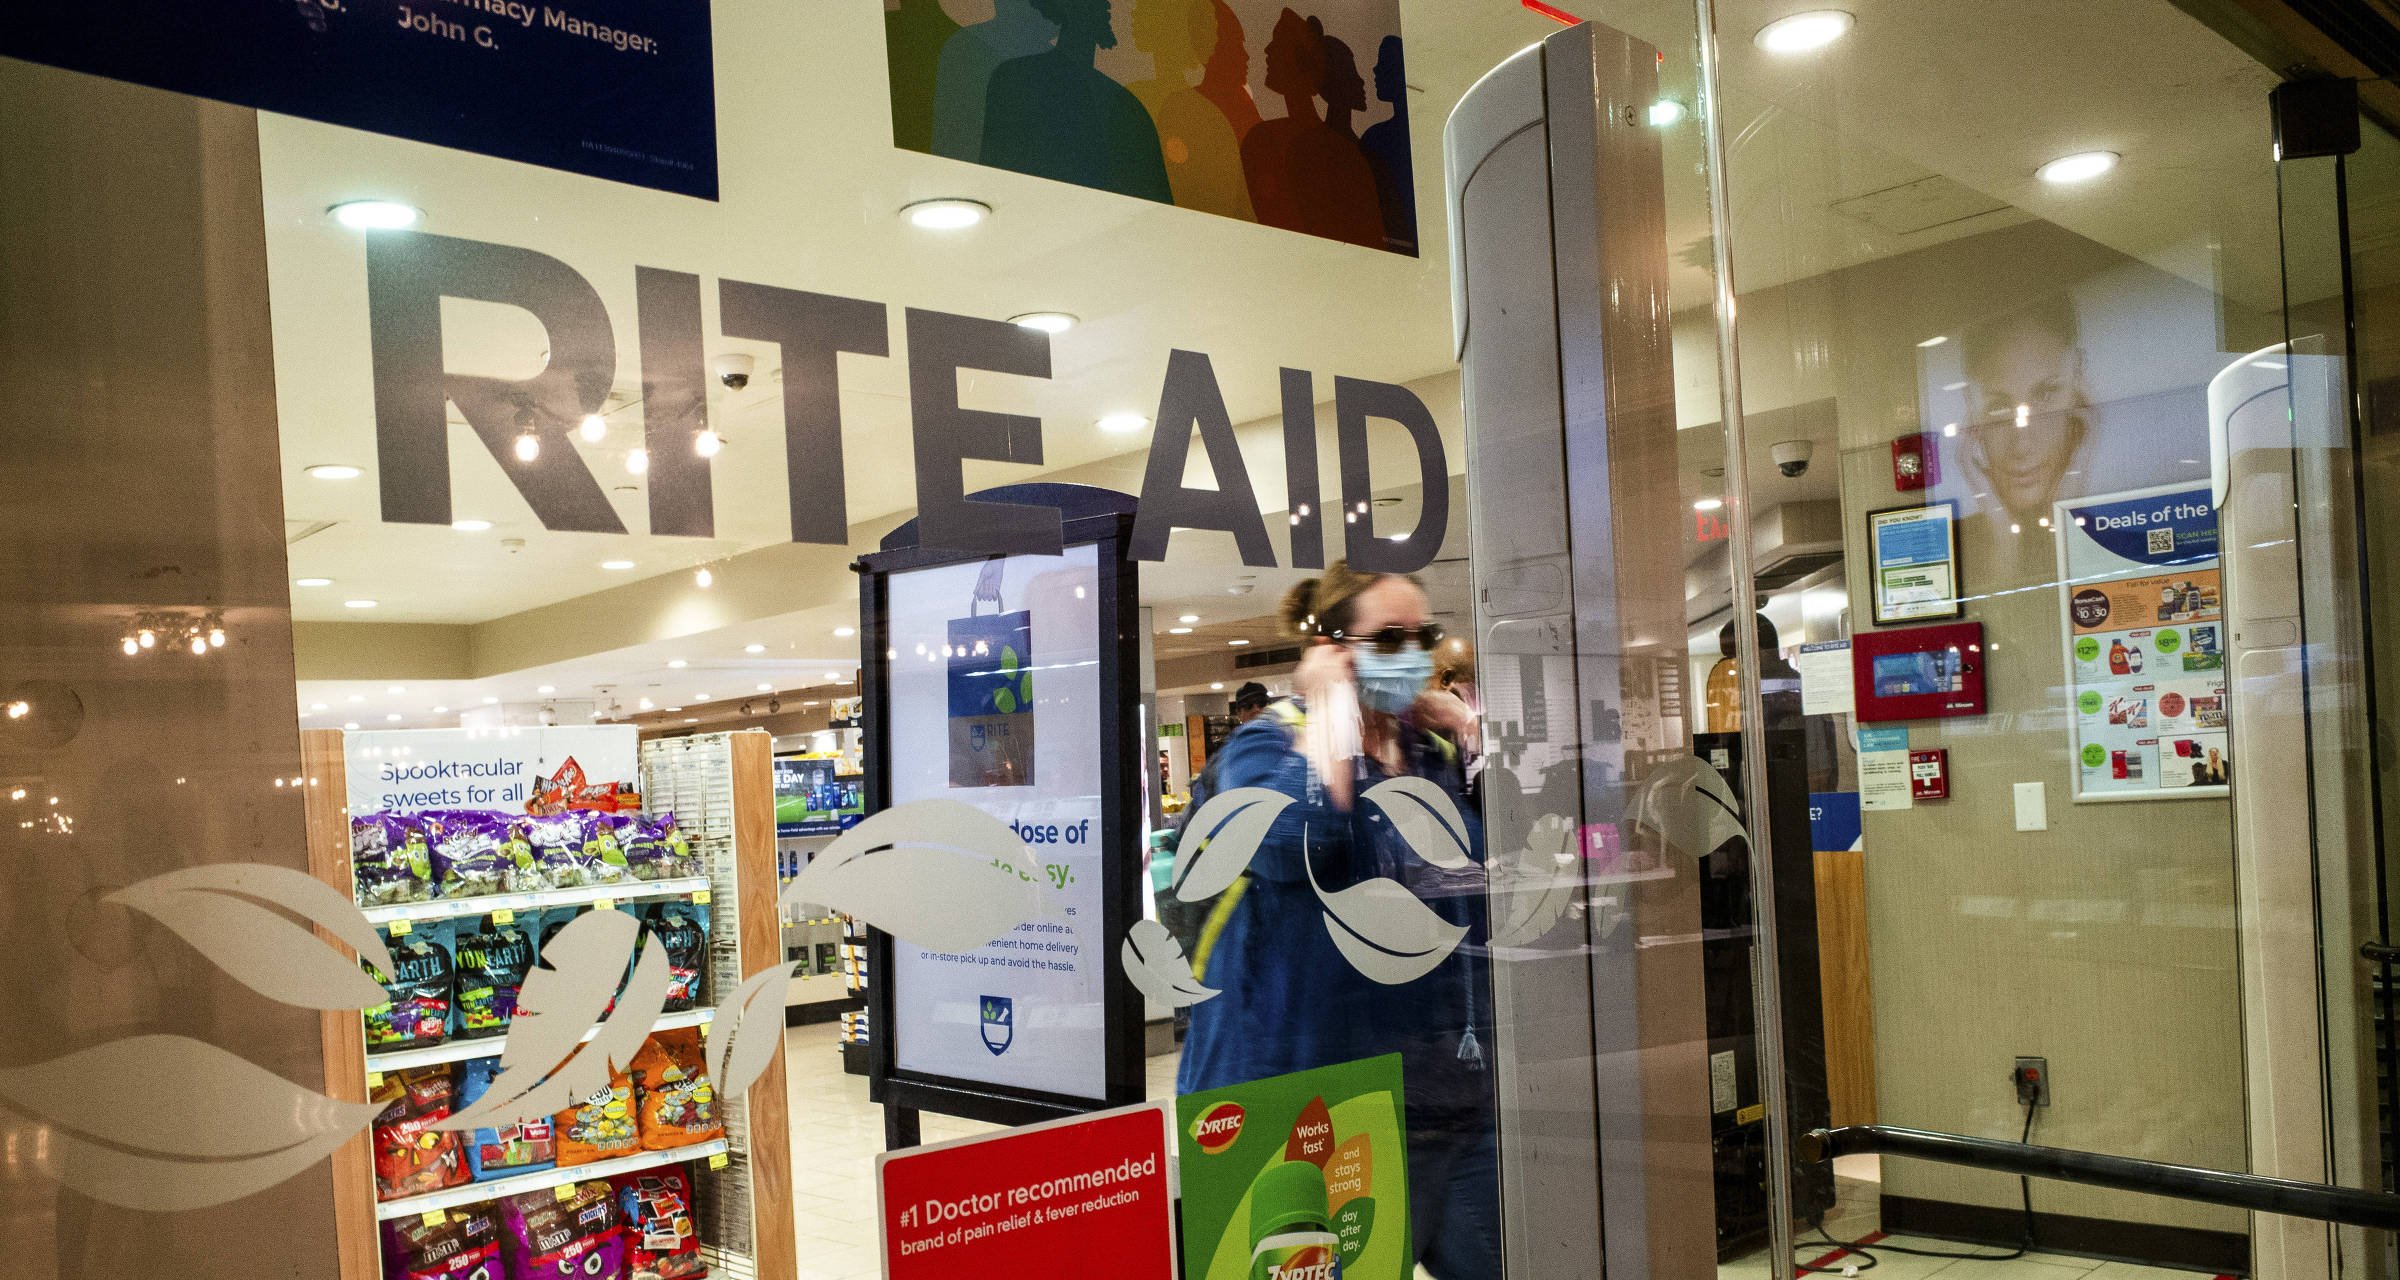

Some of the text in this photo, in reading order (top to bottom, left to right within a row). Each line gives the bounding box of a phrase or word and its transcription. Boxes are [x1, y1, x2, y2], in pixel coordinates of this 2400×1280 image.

[398, 6, 498, 49] John G.
[543, 6, 658, 55] Manager:
[367, 229, 1449, 572] RITE AID
[2095, 503, 2208, 531] Deals of the
[987, 723, 1010, 737] RITE
[380, 758, 523, 785] Spooktacular
[784, 773, 804, 784] DAY
[382, 782, 523, 809] sweets for all
[1809, 807, 1823, 821] E?
[1065, 819, 1088, 844] of
[1037, 923, 1064, 935] online
[1019, 939, 1044, 951] home
[1045, 940, 1079, 956] delivery
[920, 952, 928, 960] or
[960, 954, 977, 965] pick
[978, 957, 989, 966] up
[990, 956, 1006, 967] and
[1007, 958, 1030, 969] avoid
[1031, 959, 1046, 970] the
[1048, 961, 1076, 973] hassle.
[1196, 1115, 1242, 1136] ZYRTEC
[1297, 1121, 1329, 1139] Works
[1343, 1147, 1360, 1160] and
[1335, 1163, 1361, 1178] stays
[900, 1152, 1156, 1228] #1 Doctor recommended
[1329, 1178, 1362, 1195] strong
[901, 1188, 1140, 1256] brand of pain relief & fever reduction
[1342, 1211, 1358, 1223] day
[1340, 1223, 1362, 1238] after
[562, 1242, 583, 1259] 250
[1342, 1241, 1361, 1253] day.
[448, 1254, 469, 1271] 250
